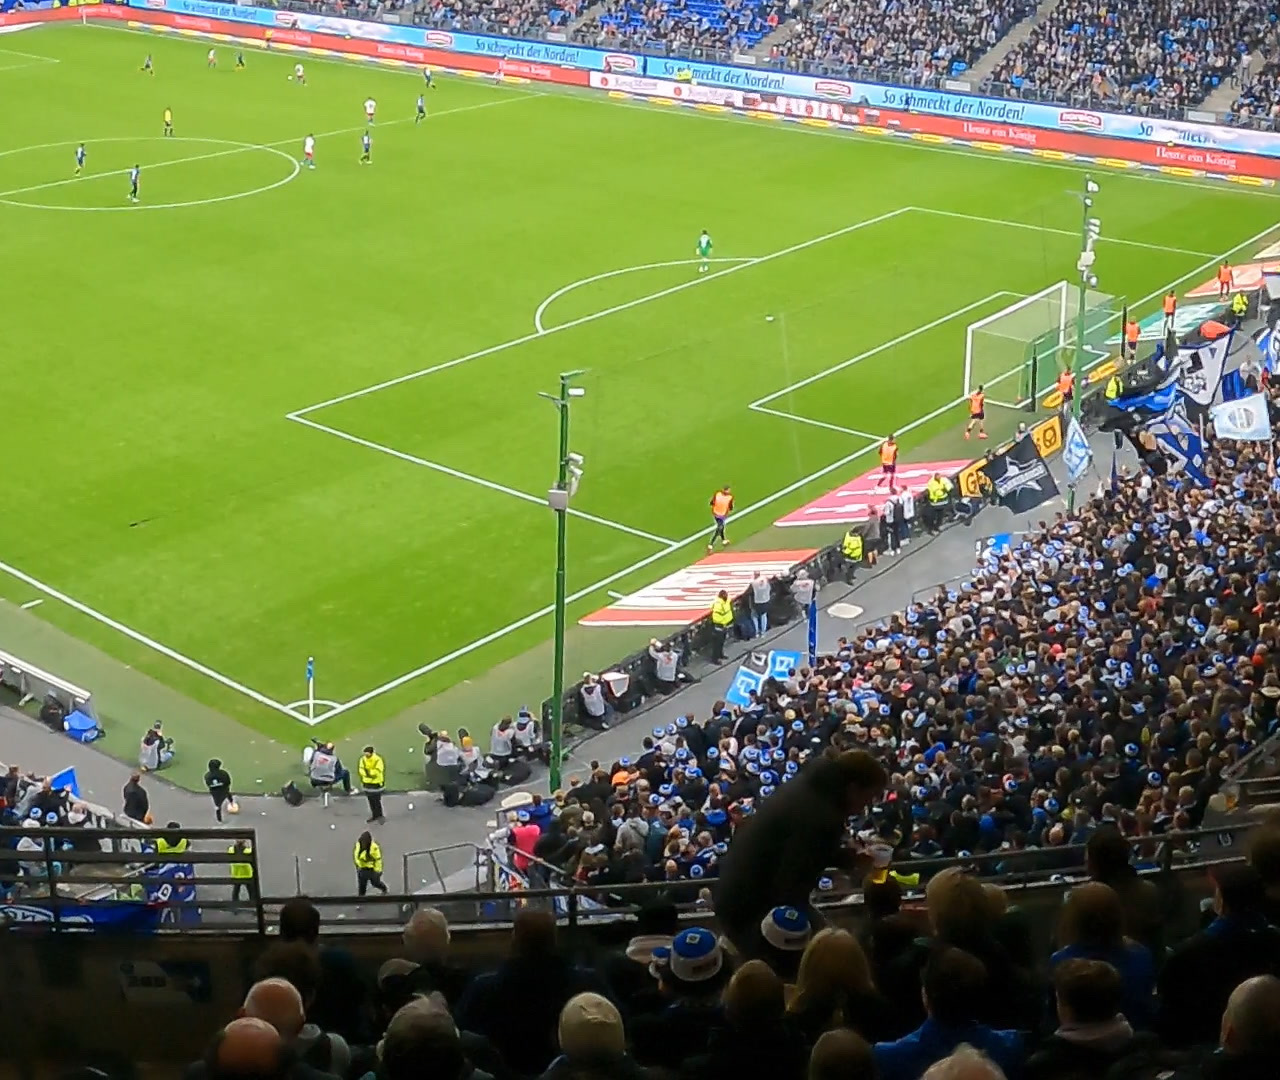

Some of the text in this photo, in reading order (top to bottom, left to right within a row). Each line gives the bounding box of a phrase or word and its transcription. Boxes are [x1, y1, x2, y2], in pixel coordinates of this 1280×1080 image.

[475, 39, 581, 63] So schmeckt der Norden!
[664, 62, 674, 75] So
[723, 70, 739, 83] der
[744, 72, 785, 89] Norden!
[883, 89, 1025, 121] So shmeckt der Norden!
[1138, 121, 1154, 137] So
